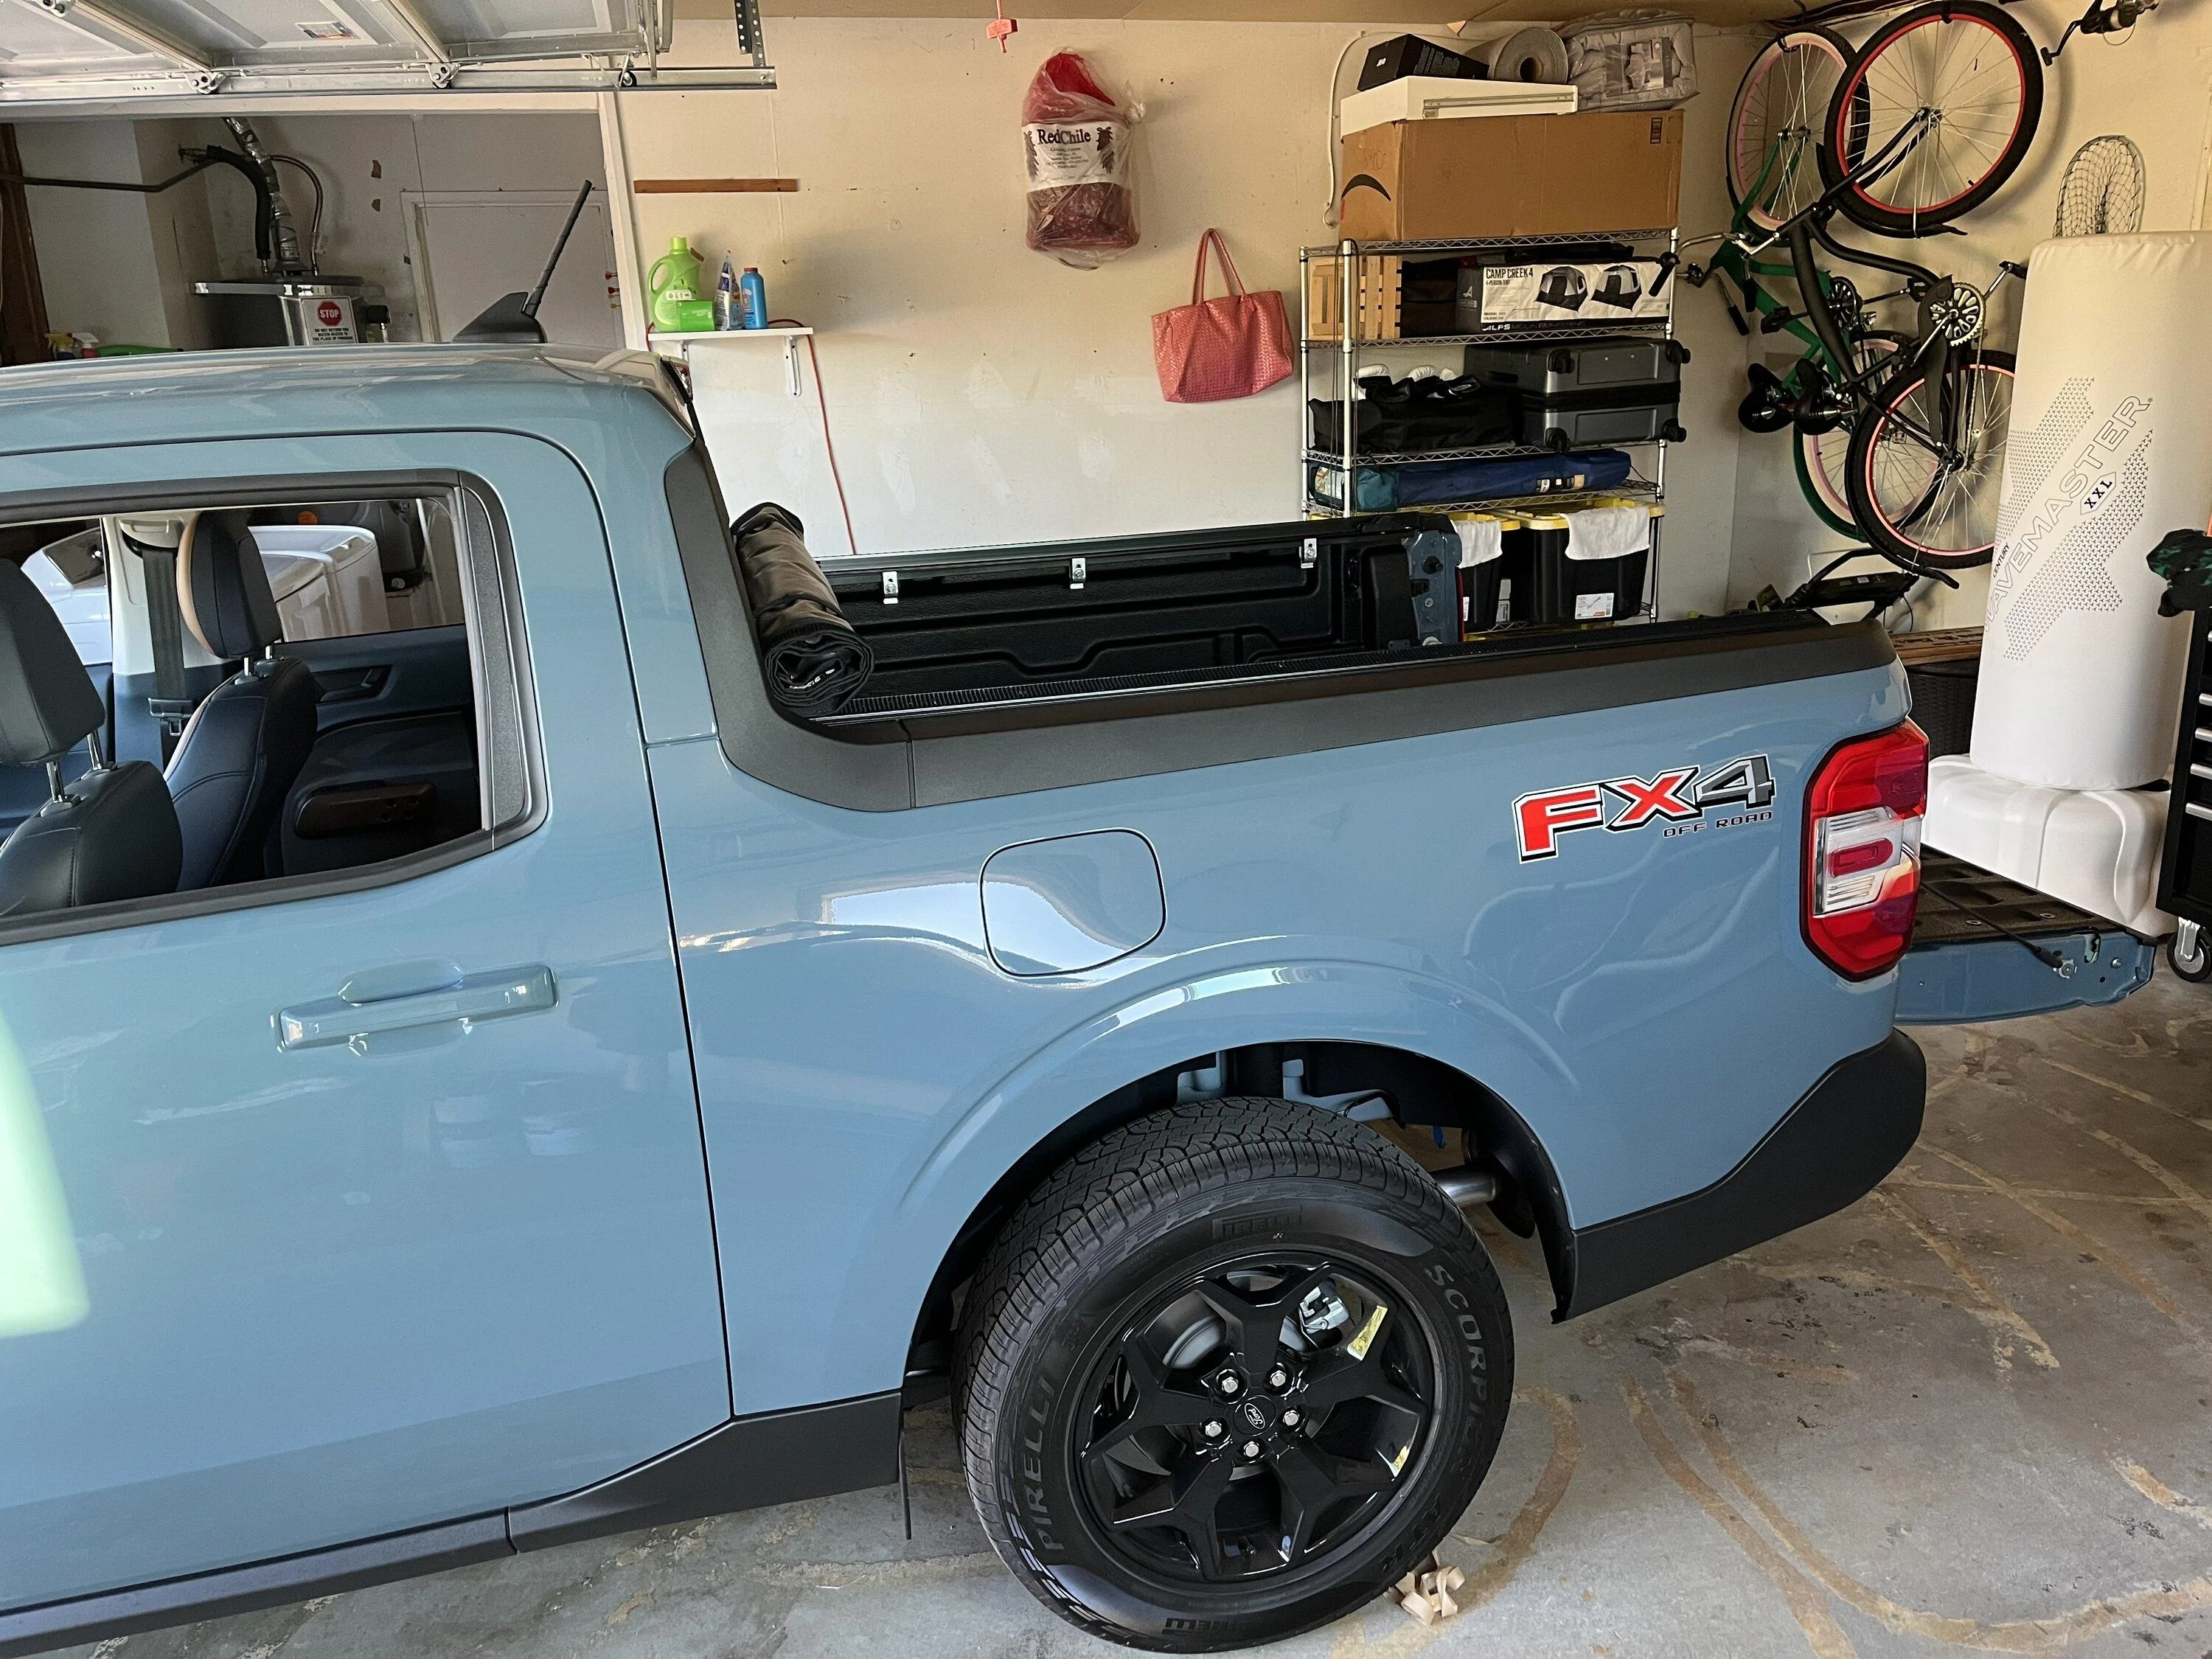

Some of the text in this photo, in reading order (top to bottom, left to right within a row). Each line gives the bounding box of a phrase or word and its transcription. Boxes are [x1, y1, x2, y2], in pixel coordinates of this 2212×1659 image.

[1486, 268, 1534, 279] CAMP CREEK 4
[319, 310, 339, 318] STOP
[2084, 480, 2113, 509] XXL
[1992, 542, 2010, 578] CENTURY
[1512, 754, 1775, 864] FX4
[1663, 810, 1773, 838] OFF ROAD
[1022, 1375, 1065, 1549] PIRELLI
